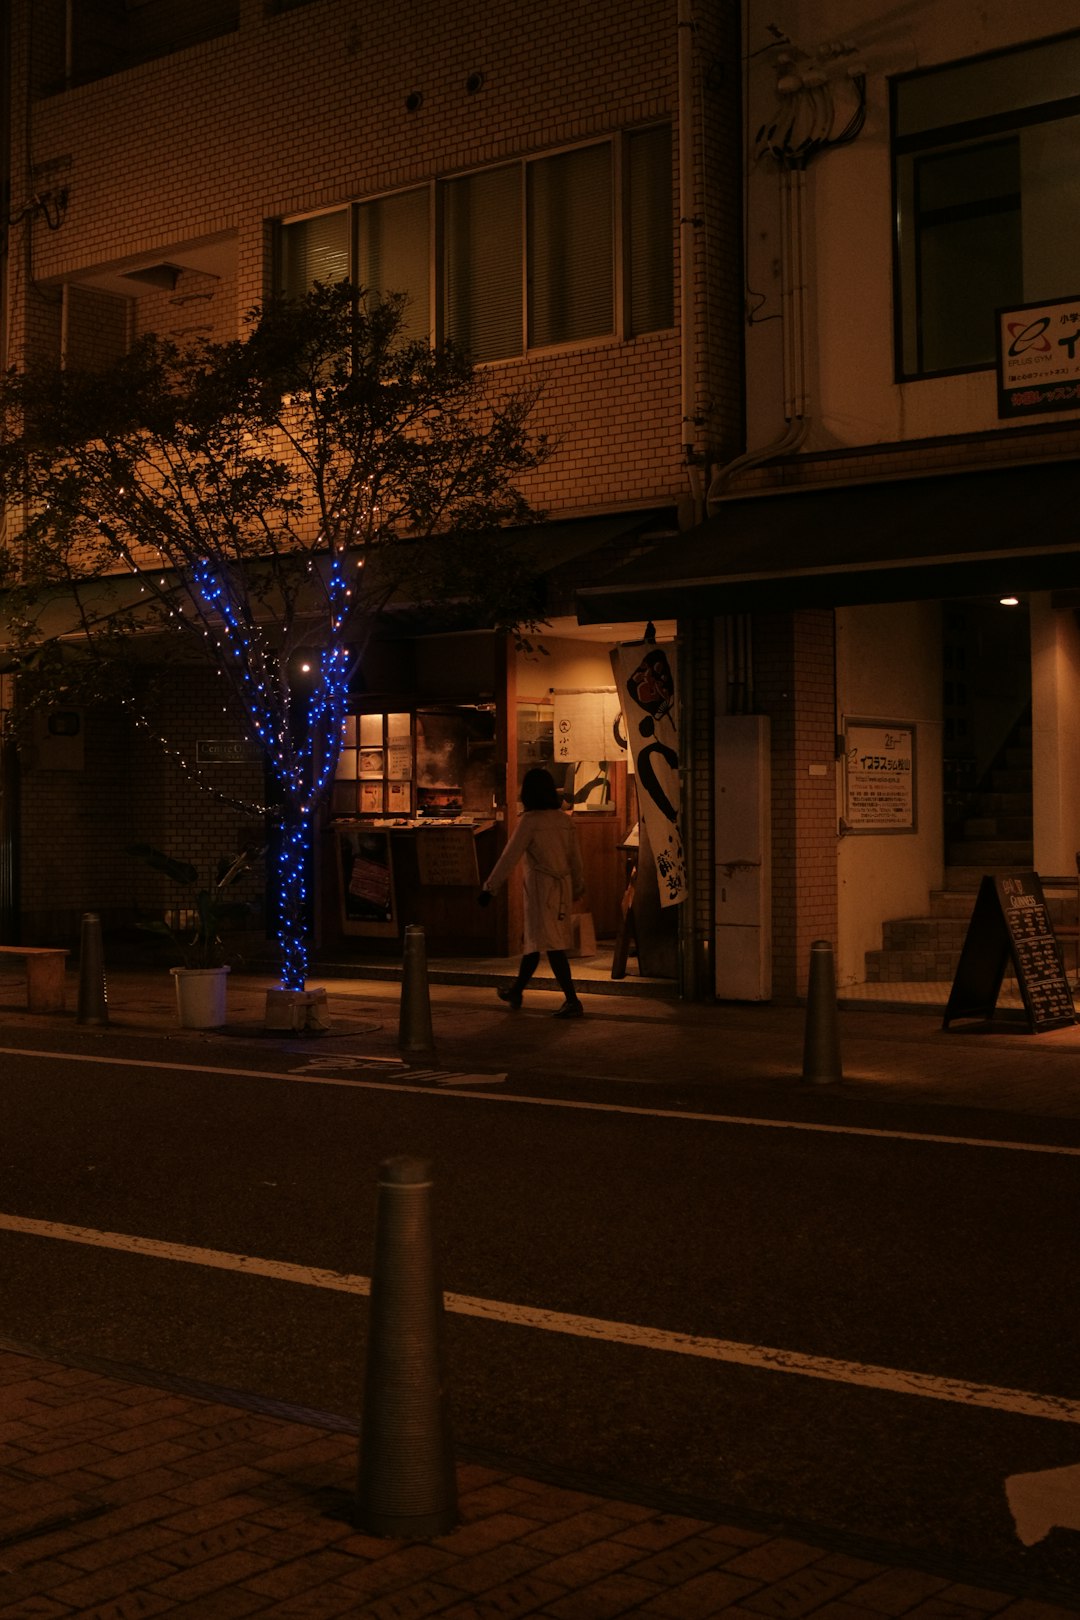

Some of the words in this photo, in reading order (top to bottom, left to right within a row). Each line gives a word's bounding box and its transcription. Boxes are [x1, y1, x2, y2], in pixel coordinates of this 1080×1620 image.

[1060, 312, 1080, 325] 小学
[1008, 357, 1033, 367] EPLUS
[1034, 354, 1053, 364] GYM
